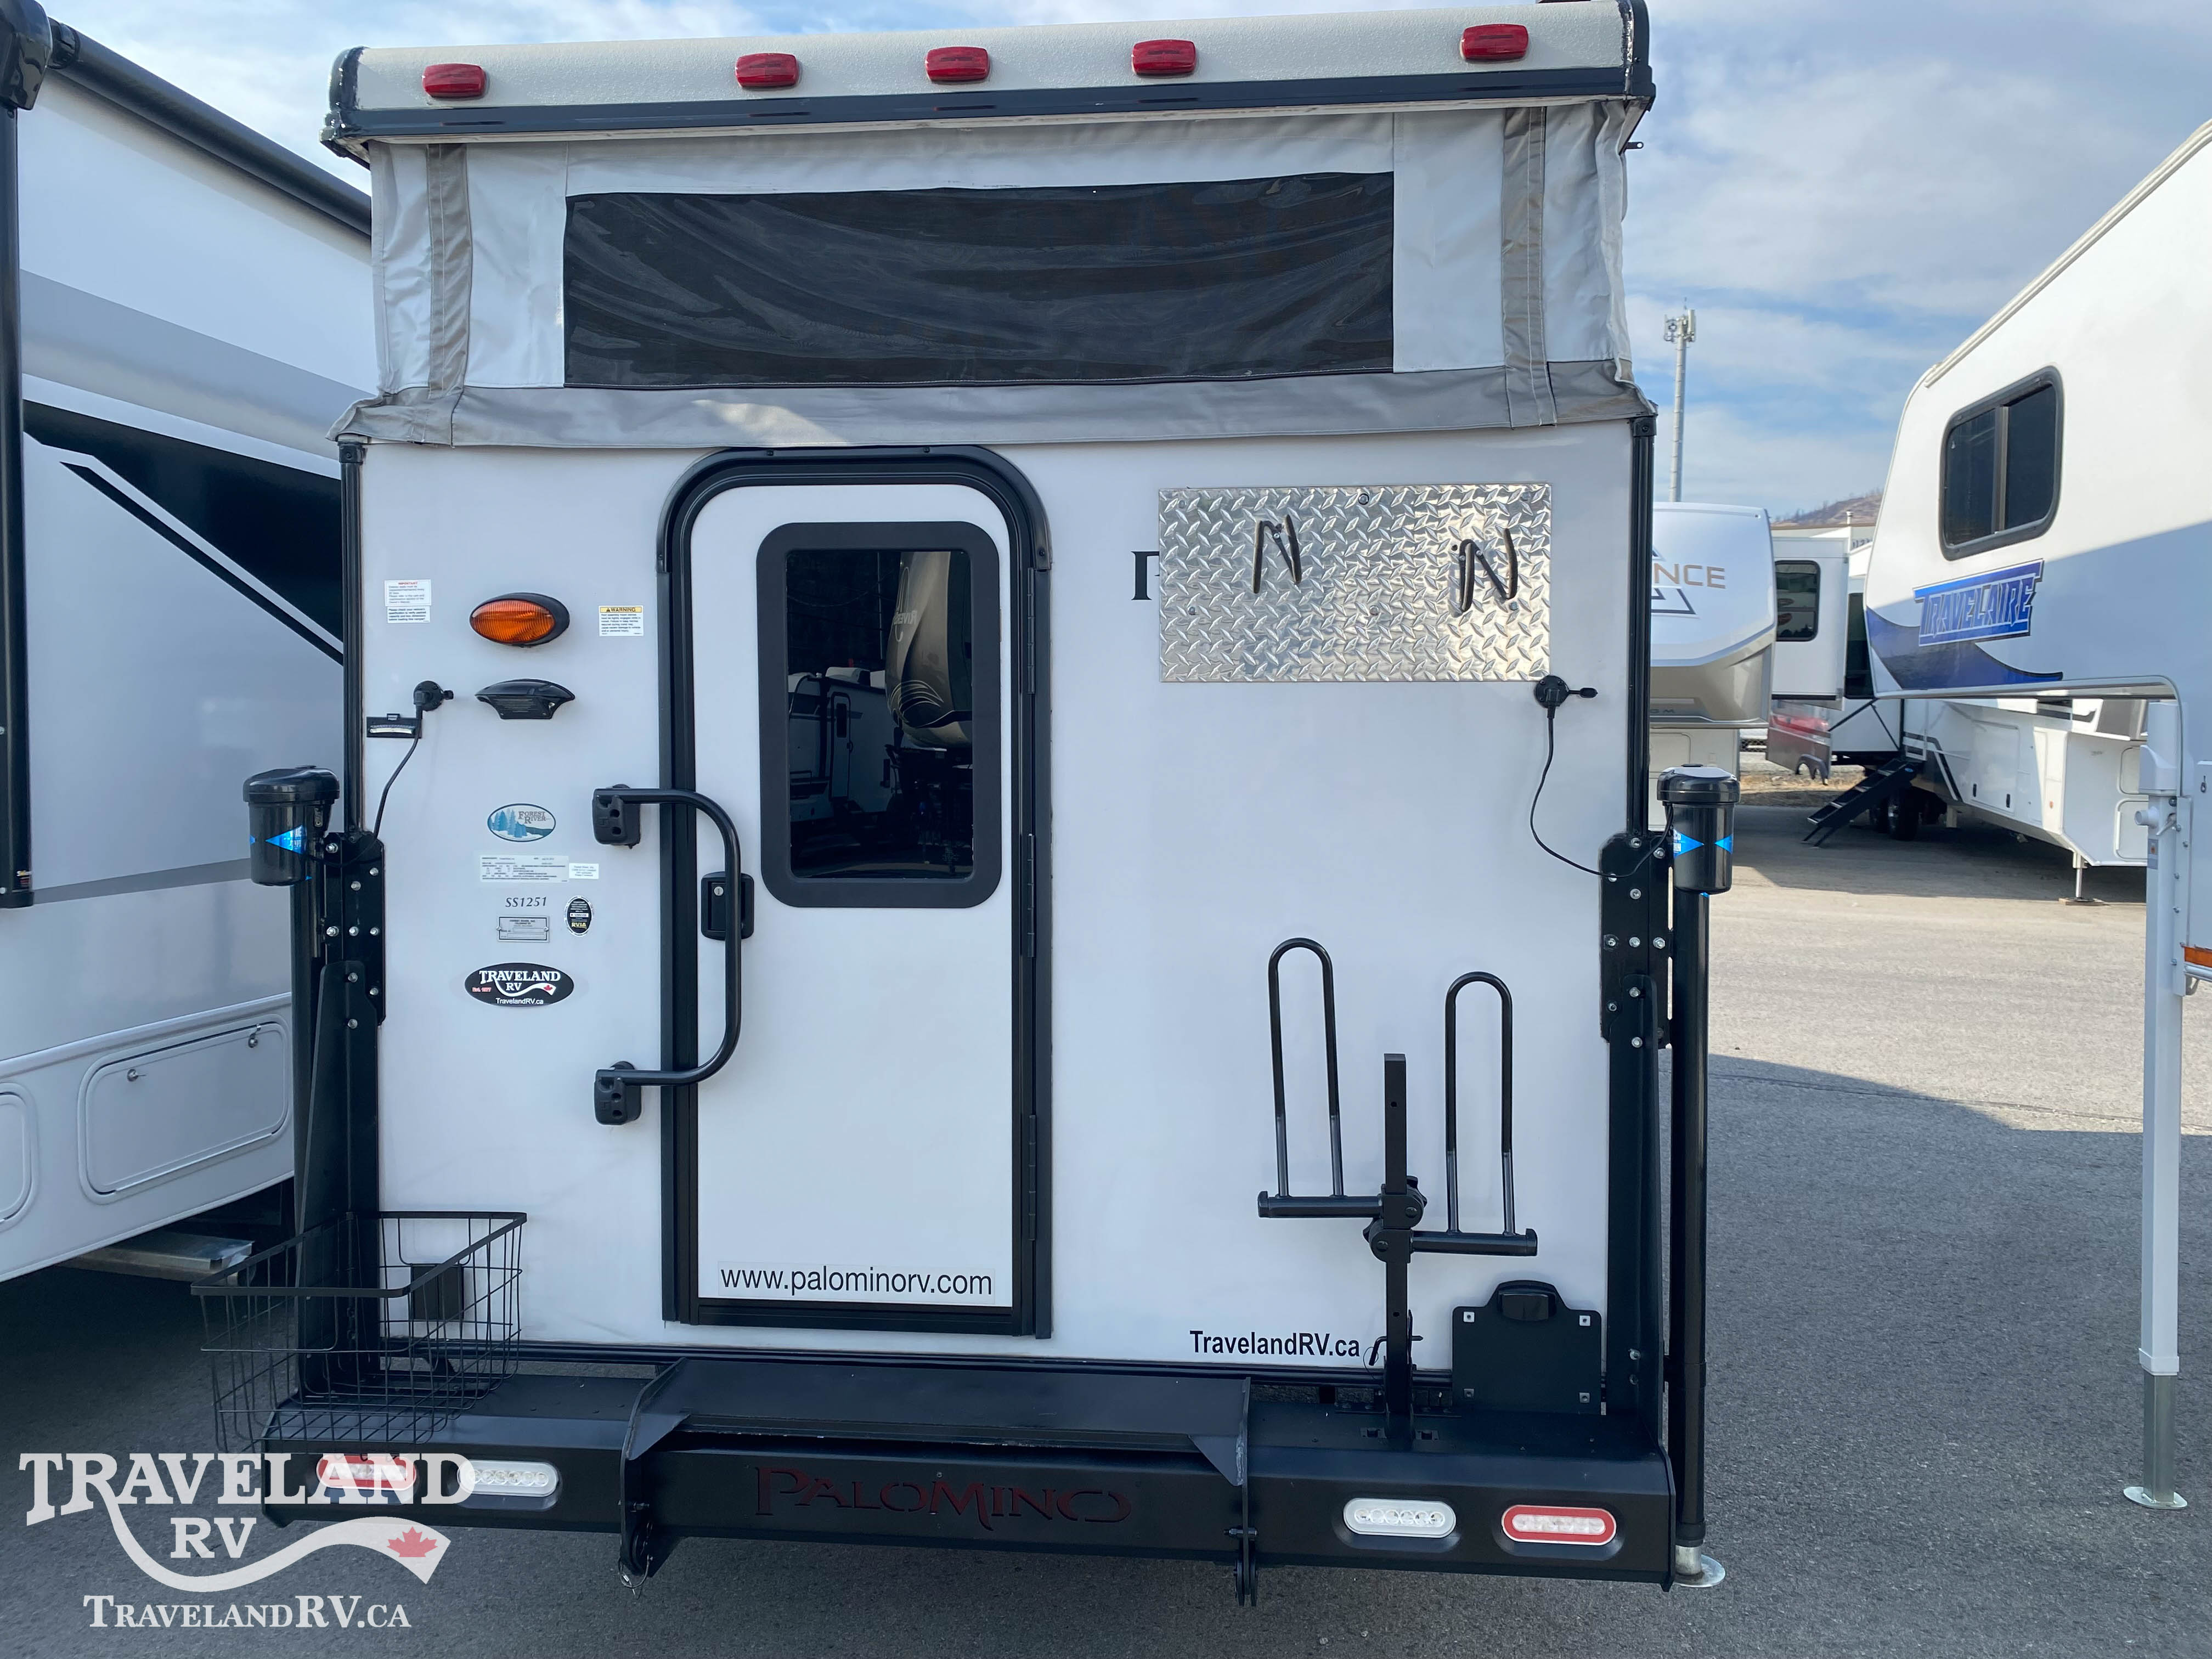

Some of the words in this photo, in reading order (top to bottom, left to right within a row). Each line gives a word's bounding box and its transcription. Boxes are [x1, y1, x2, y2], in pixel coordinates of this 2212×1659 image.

[1915, 563, 2041, 643] TRAVELAIRE
[518, 811, 545, 820] FOREST
[524, 816, 546, 824] RIVER
[505, 896, 547, 907] SS1251
[479, 970, 561, 985] TRAVELAND
[506, 983, 522, 991] RV
[720, 1266, 992, 1295] www.palominorv.com
[1189, 1330, 1360, 1357] TravelandRV.ca
[755, 1466, 1132, 1531] PALOMINO
